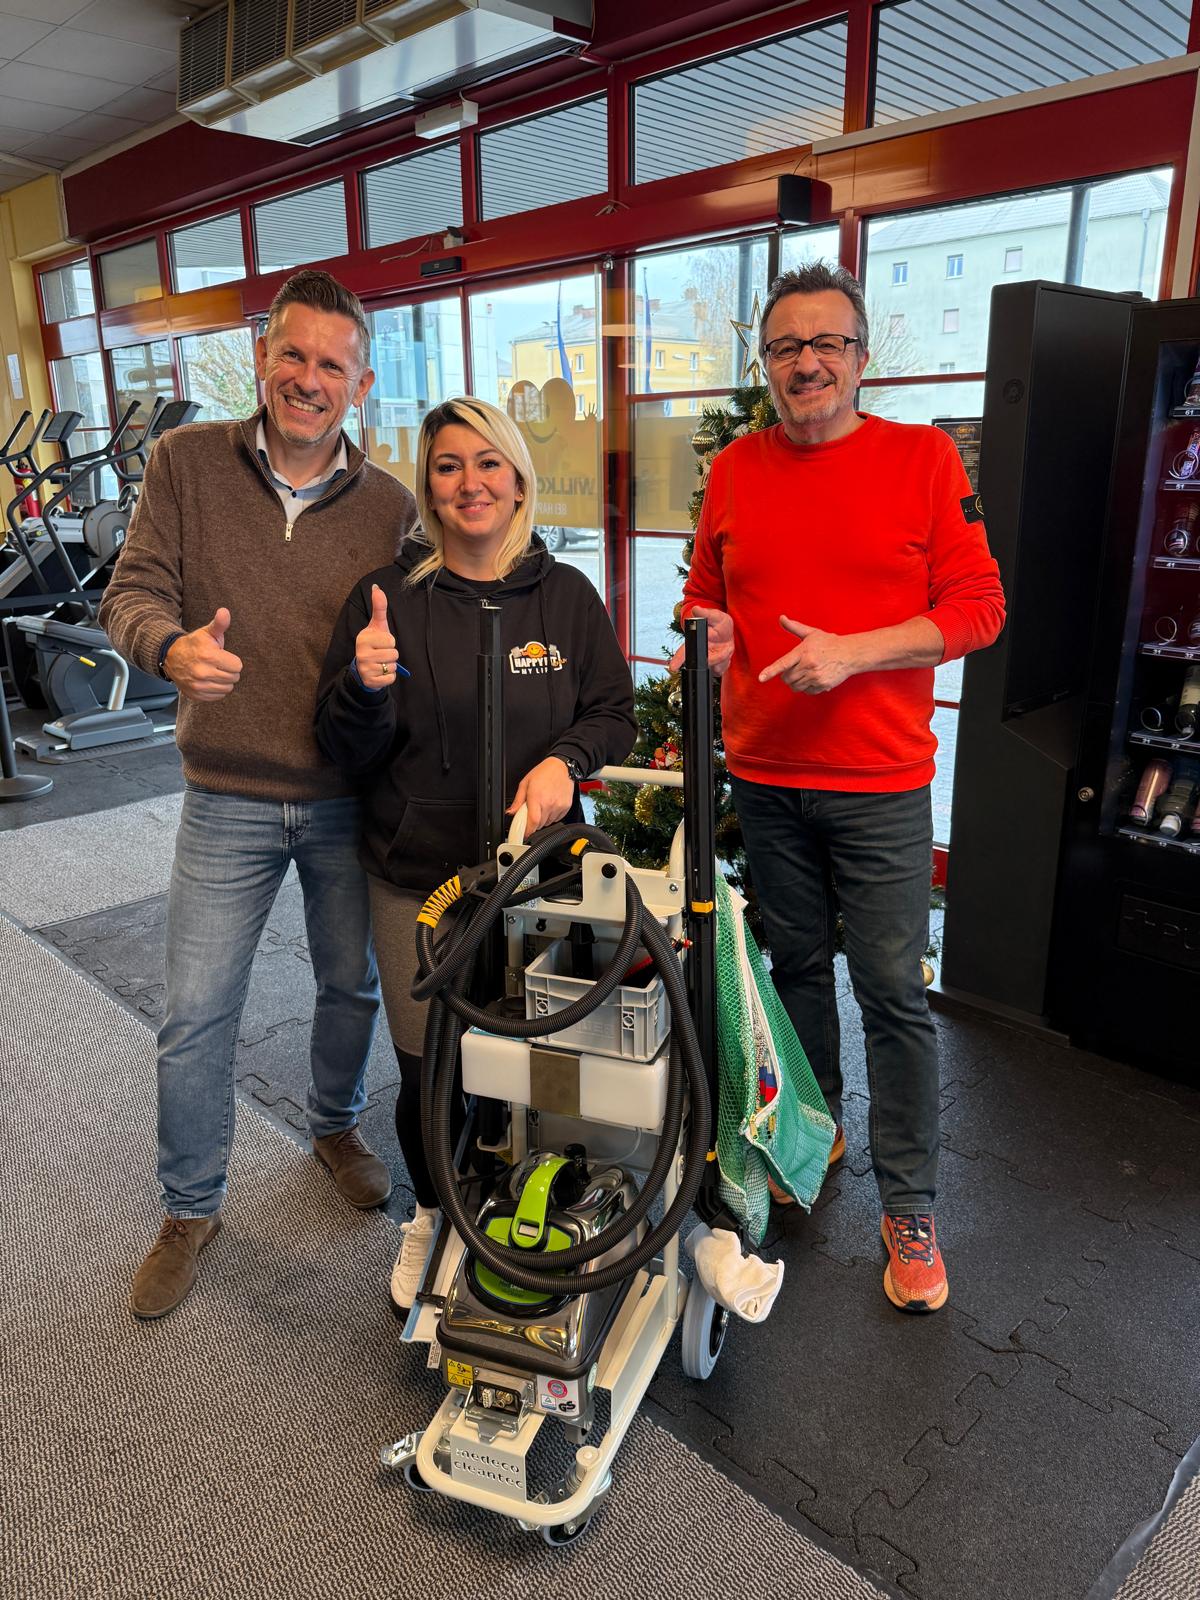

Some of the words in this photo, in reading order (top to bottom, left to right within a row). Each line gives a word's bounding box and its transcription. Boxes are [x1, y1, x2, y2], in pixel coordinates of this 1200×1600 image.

[559, 1401, 576, 1412] GS
[455, 1447, 520, 1474] medeco
[453, 1460, 524, 1489] cleantec
